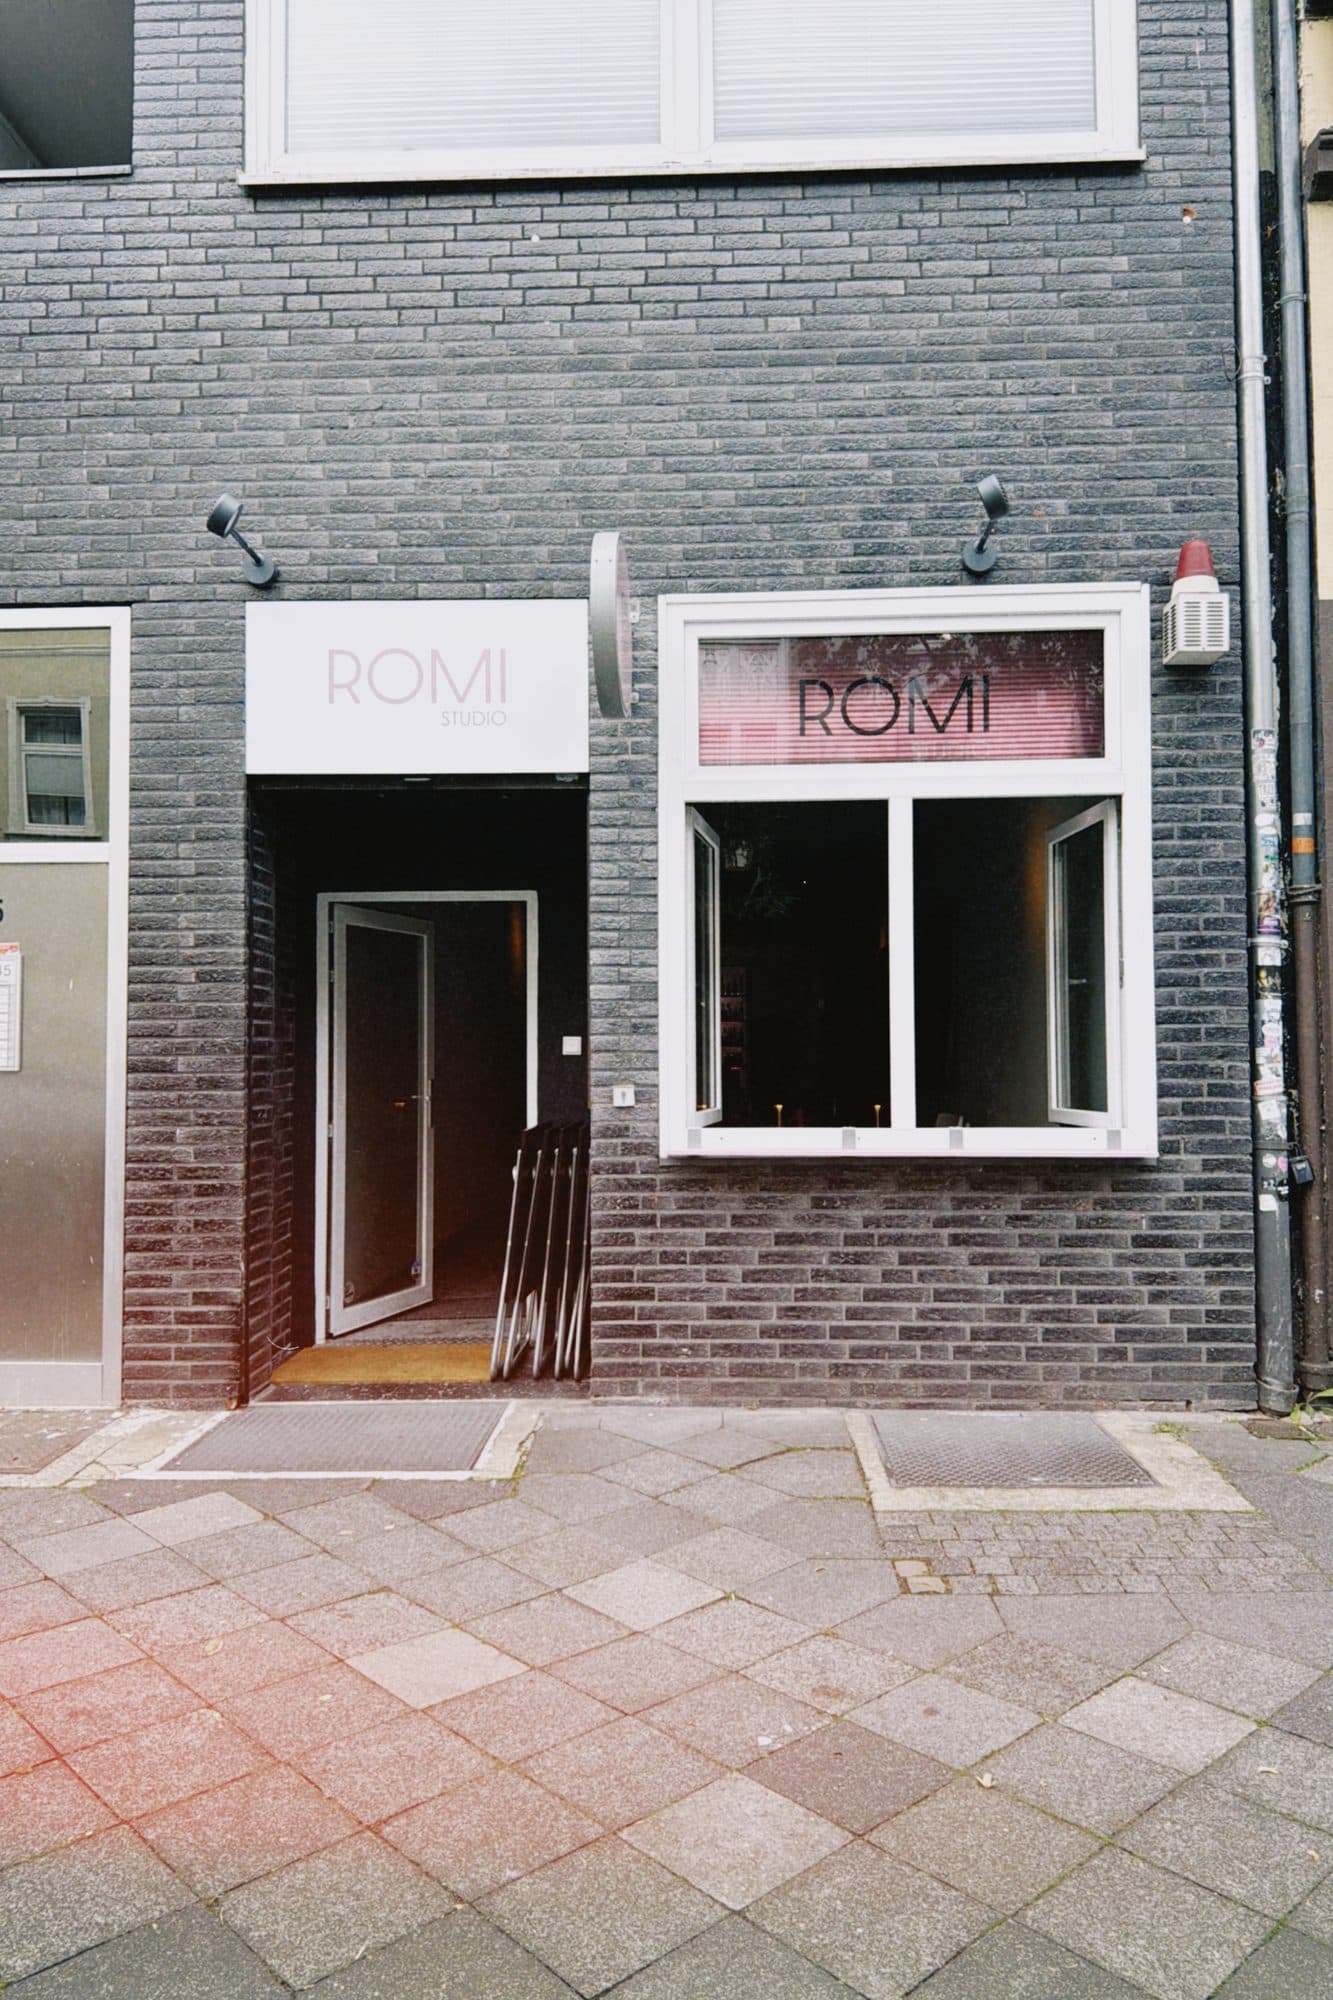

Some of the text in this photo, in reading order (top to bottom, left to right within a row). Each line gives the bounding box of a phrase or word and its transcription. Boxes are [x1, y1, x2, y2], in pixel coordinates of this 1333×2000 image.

[328, 648, 507, 704] ROMI
[442, 711, 507, 727] STUDIO
[799, 675, 990, 736] ROMI
